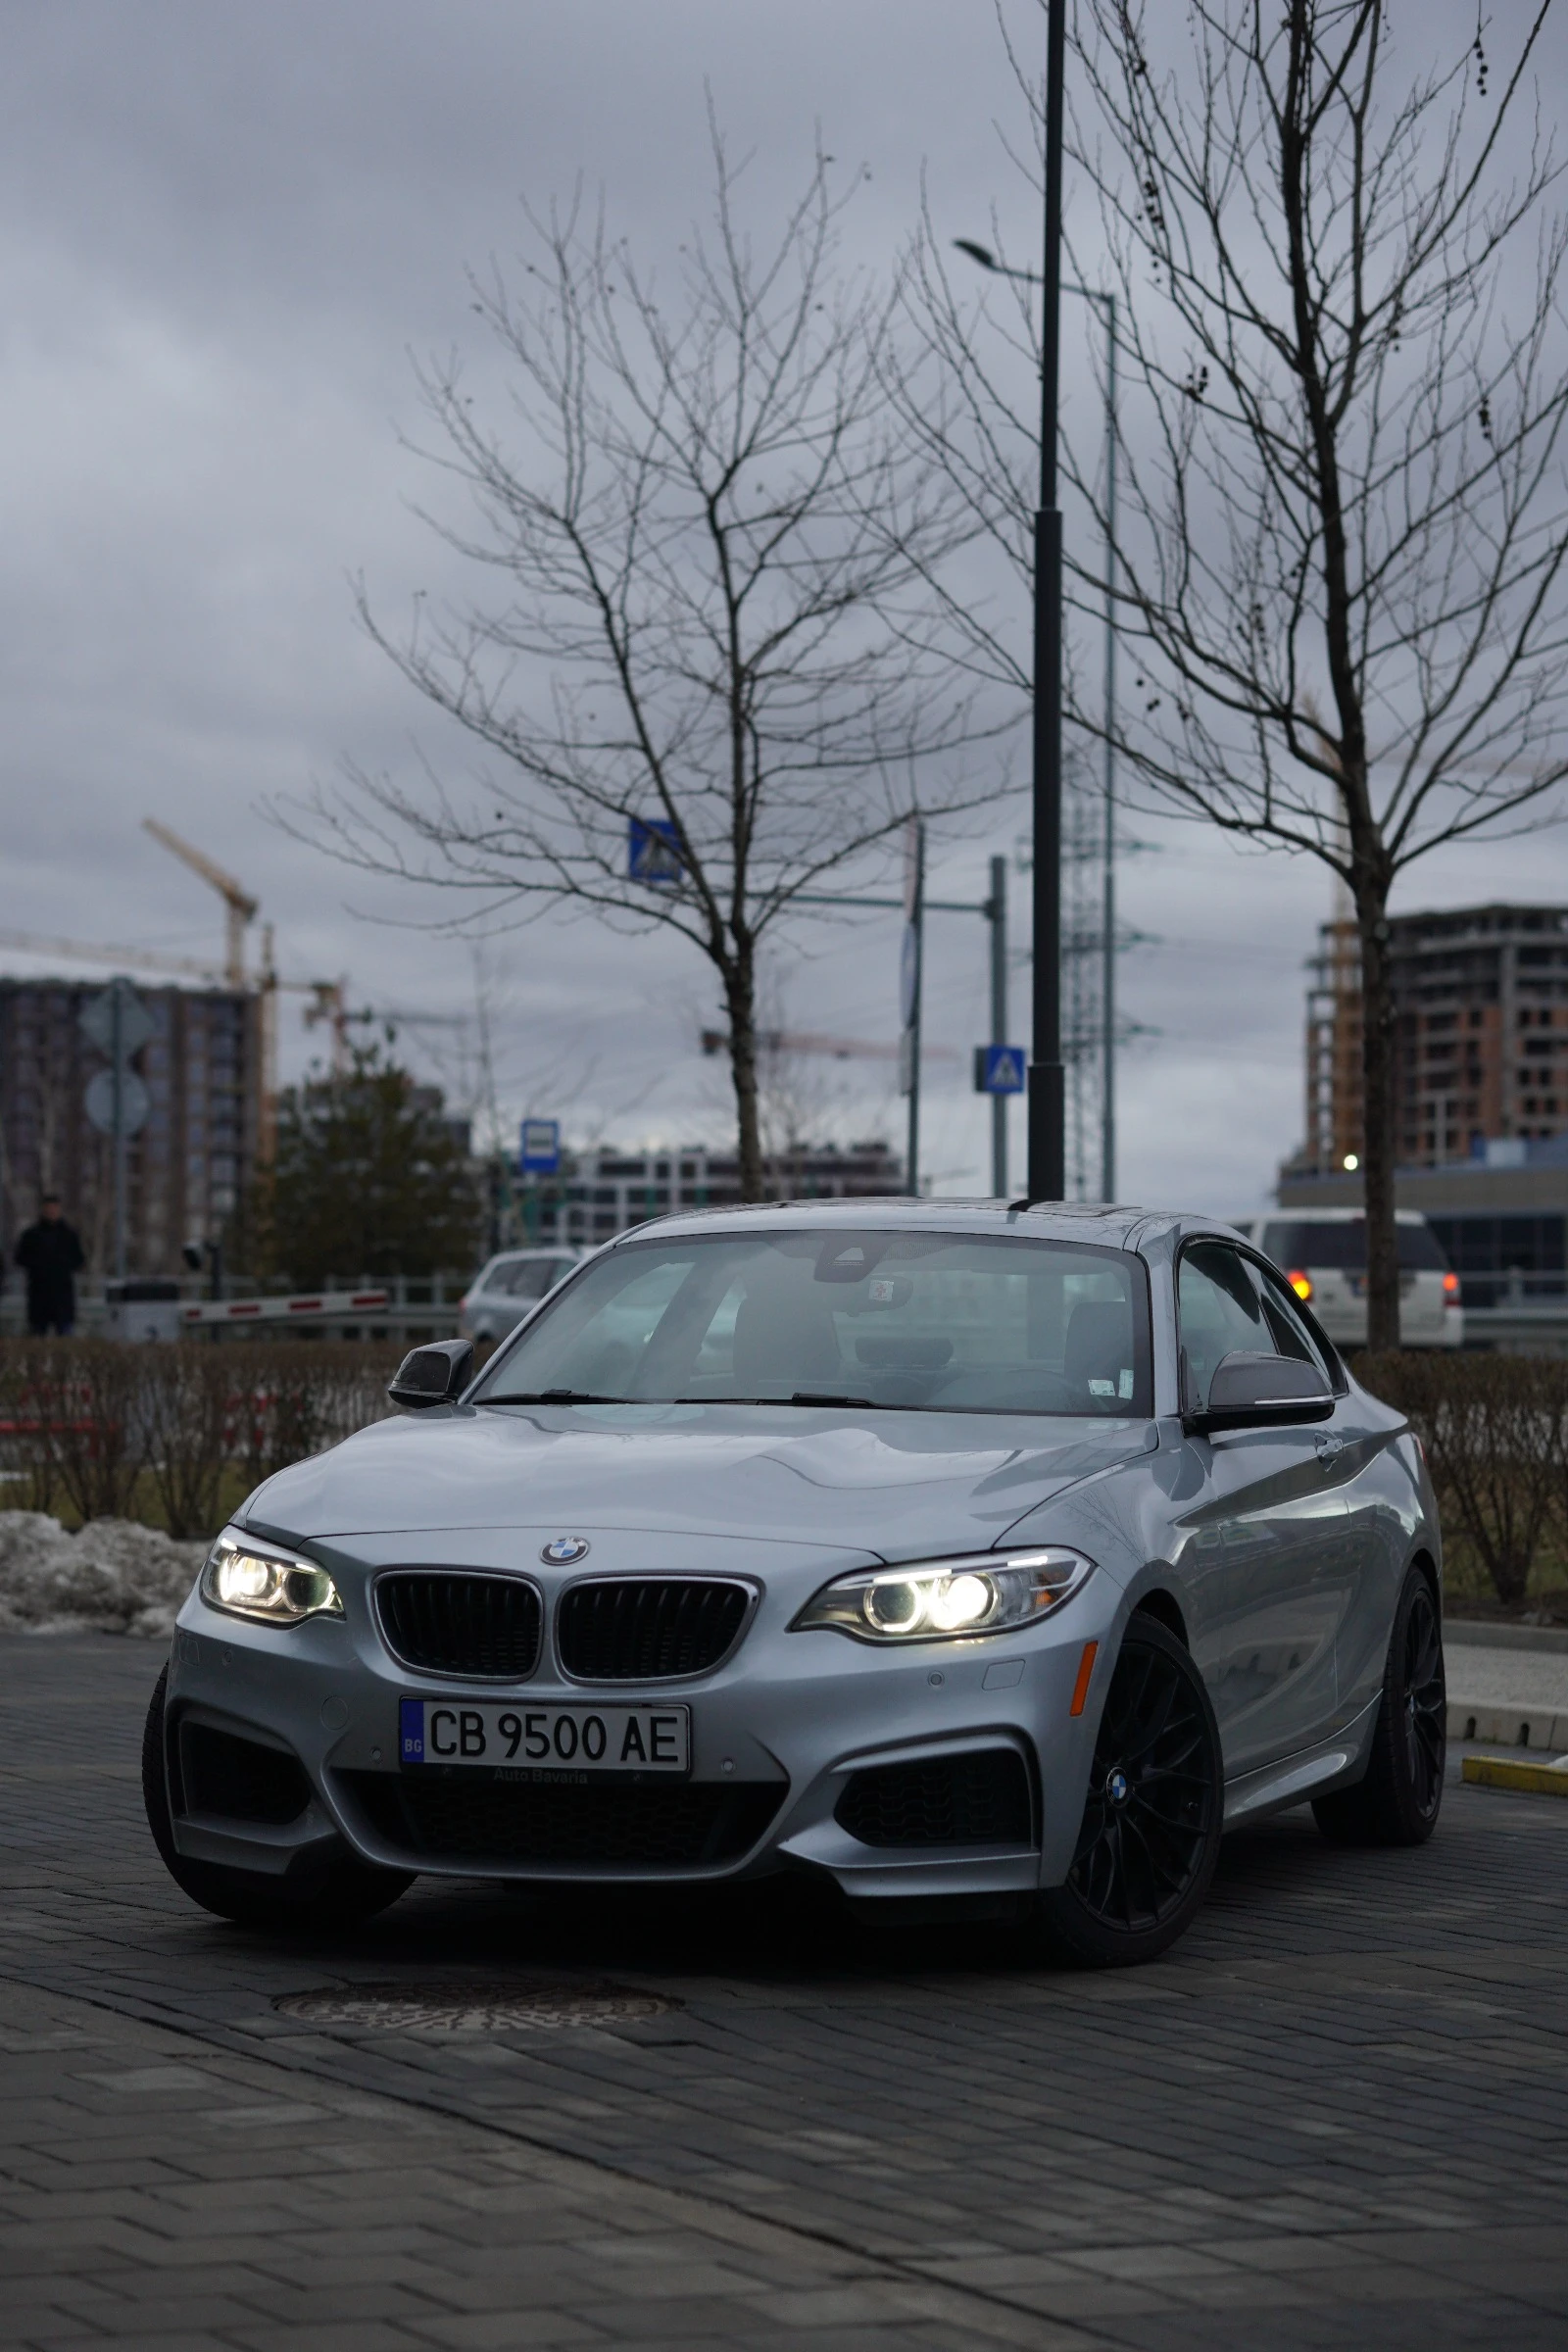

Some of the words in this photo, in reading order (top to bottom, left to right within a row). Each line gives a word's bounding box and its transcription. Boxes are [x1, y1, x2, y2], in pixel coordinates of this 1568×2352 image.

[405, 1739, 422, 1752] BG
[430, 1710, 486, 1756] CB
[498, 1712, 607, 1761] 9500
[620, 1715, 679, 1762] AE
[493, 1766, 529, 1783] Auto
[532, 1768, 588, 1785] Bavaria
